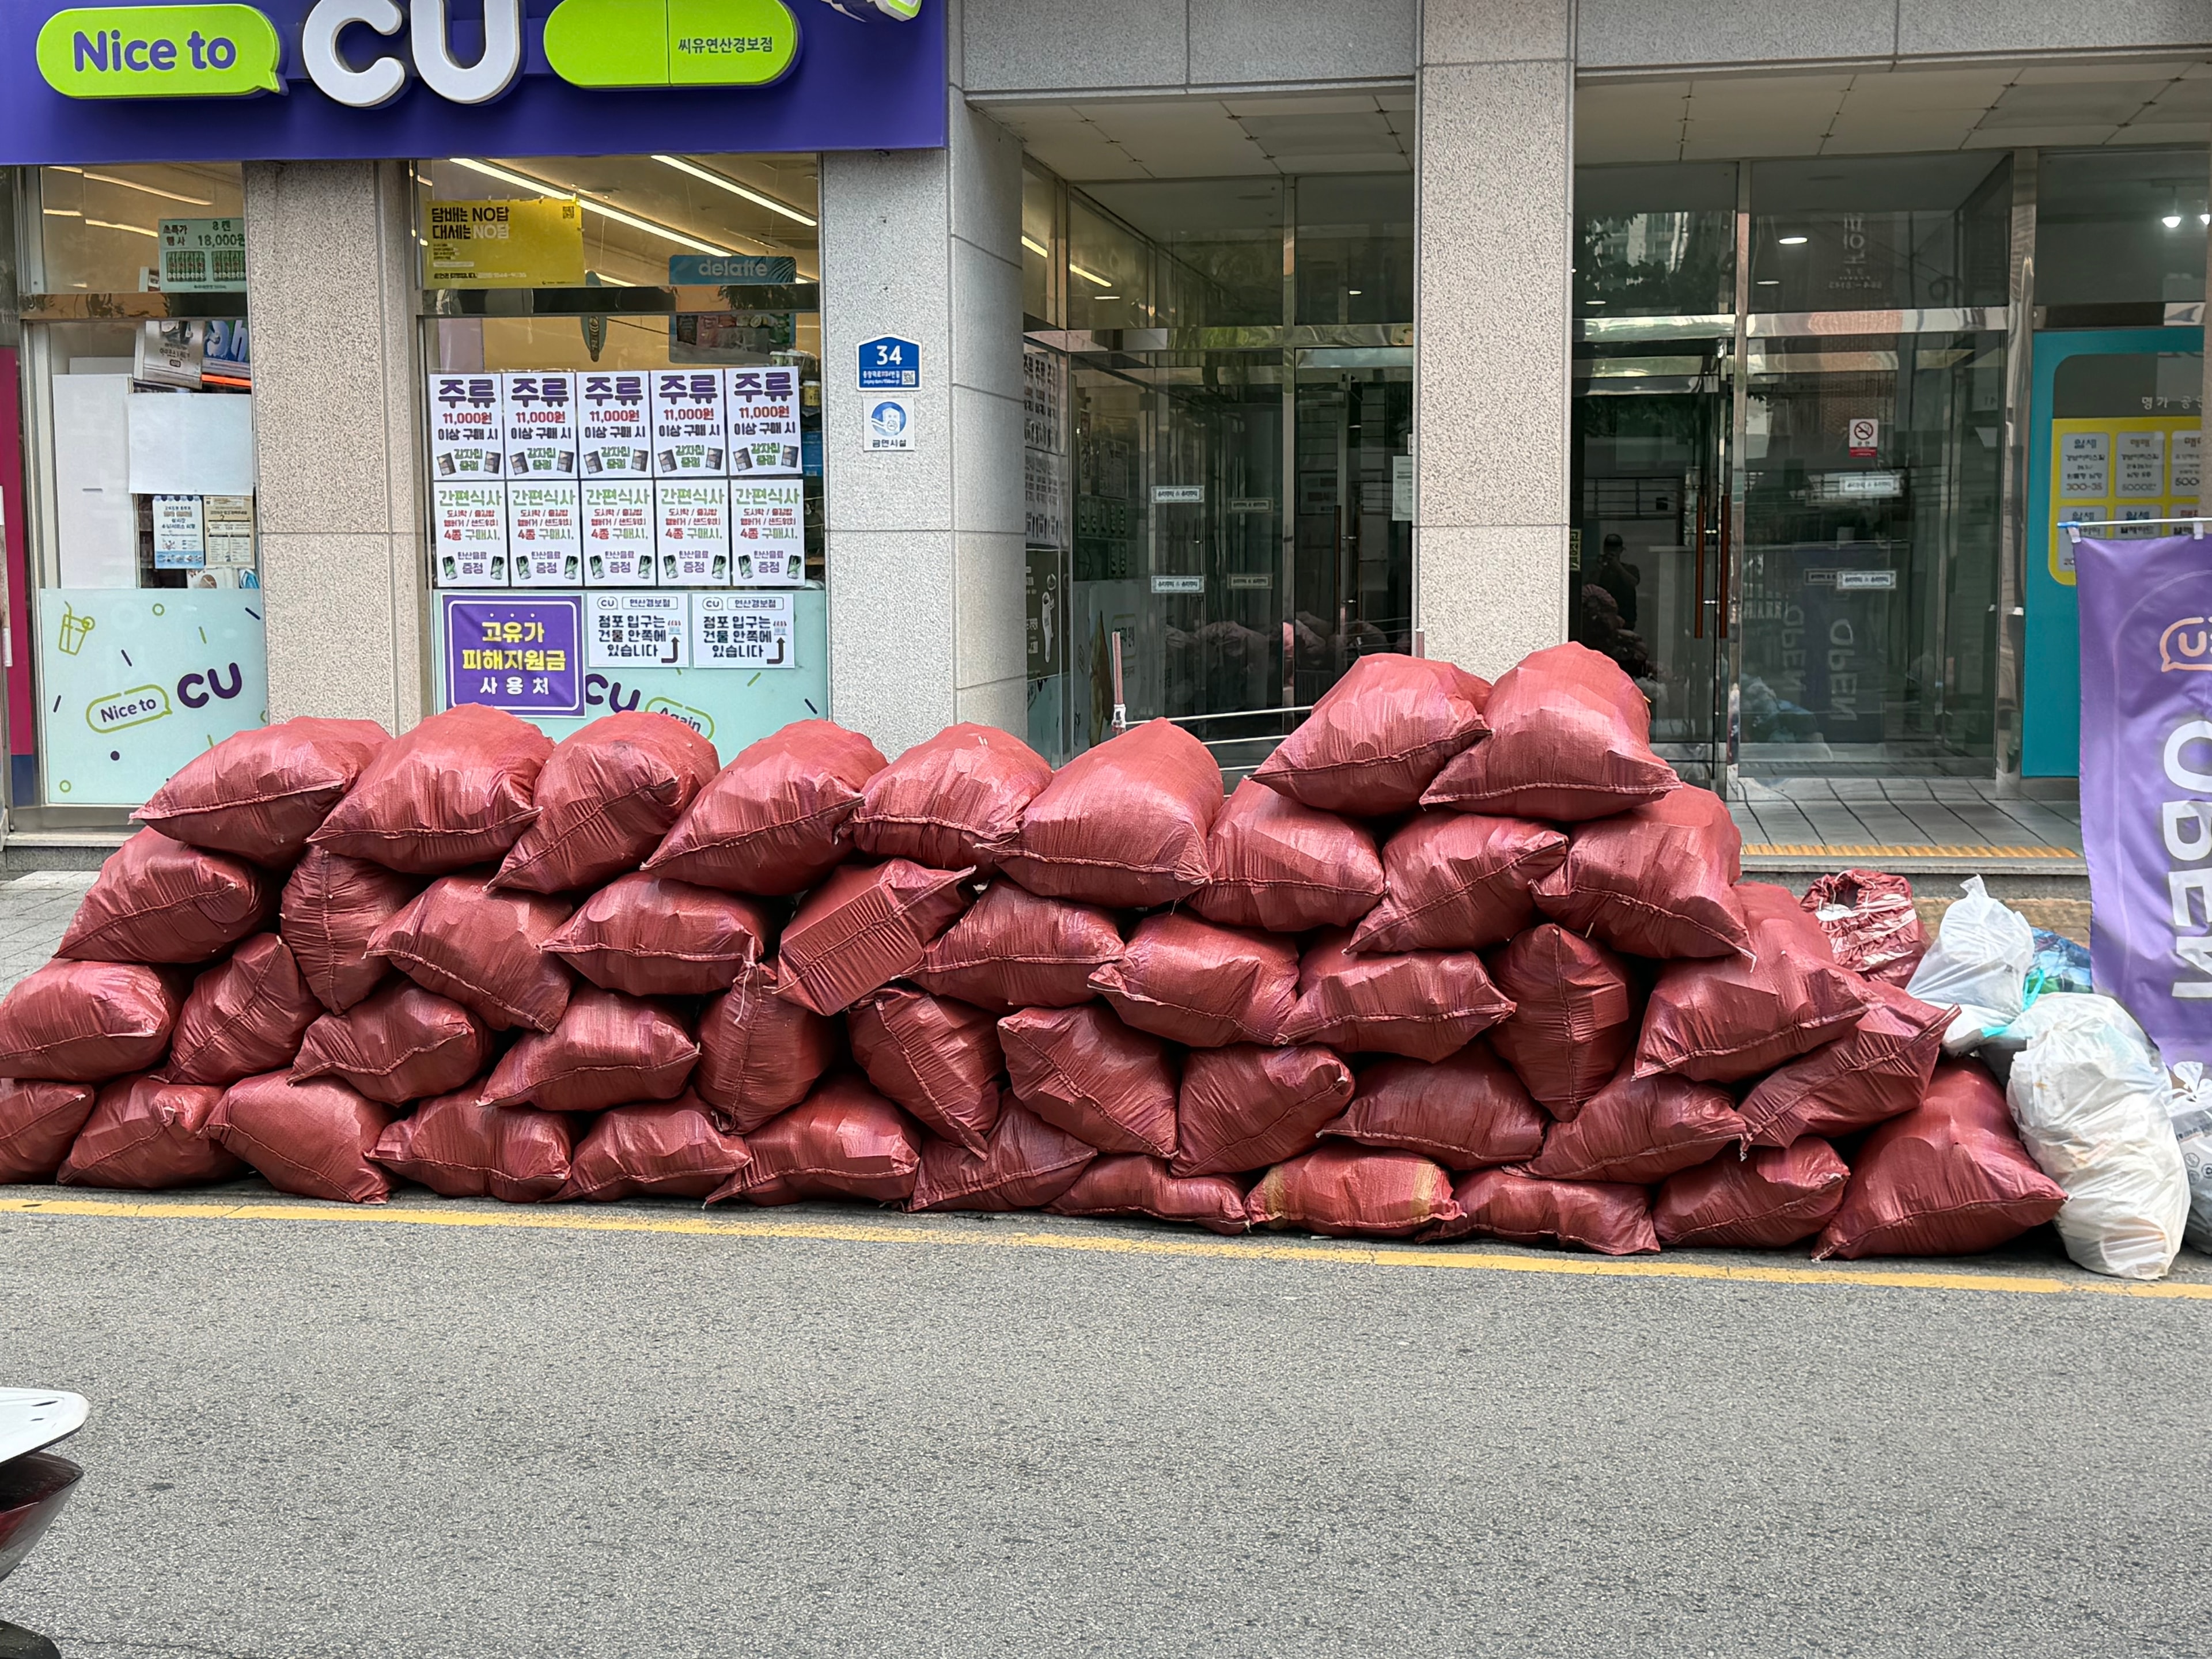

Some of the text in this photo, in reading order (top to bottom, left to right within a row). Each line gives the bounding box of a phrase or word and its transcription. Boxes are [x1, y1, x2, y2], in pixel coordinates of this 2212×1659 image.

[74, 29, 236, 71] Nice to
[302, 0, 517, 107] CU
[677, 37, 773, 55] 씨유연산경보점
[432, 206, 509, 223] 담배는 NO답
[433, 224, 510, 240] 대세는 NO답
[876, 345, 903, 365] 34
[438, 379, 496, 408] 주류
[512, 378, 569, 407] 주류
[585, 377, 643, 406] 주류
[660, 375, 717, 404] 주류
[735, 373, 793, 402] 주류
[442, 412, 492, 425] 11,000원
[516, 411, 565, 424] 11,000원
[589, 410, 639, 423] 11,000원
[664, 408, 713, 421] 11,000원
[739, 406, 789, 419] 11,000원
[438, 428, 498, 441] 이상 구매 시
[510, 427, 571, 440] 이상 구매 시
[585, 426, 645, 438] 이상 구매 시
[659, 424, 719, 437] 이상 구매 시
[734, 422, 795, 435] 이상 구매 시
[872, 439, 907, 448] 금연시설
[438, 490, 502, 506] 간편식사
[512, 489, 575, 506] 간편식사
[586, 488, 649, 505] 간편식사
[661, 488, 724, 505] 간편식사
[736, 488, 800, 505] 간편식사
[630, 599, 671, 608] 연산경보점
[735, 599, 777, 609] 연산경보점
[599, 615, 665, 628] 점포 입구는
[703, 616, 771, 629] 점포 입구는
[482, 622, 545, 643] 고유가
[599, 629, 666, 643] 건물 안쪽에
[703, 630, 772, 643] 건물 안쪽에
[607, 644, 658, 657] 있습니다
[712, 645, 764, 658] 있습니다
[462, 649, 566, 671] 피해지원금
[177, 662, 243, 709] CU
[100, 698, 157, 723] Nice to
